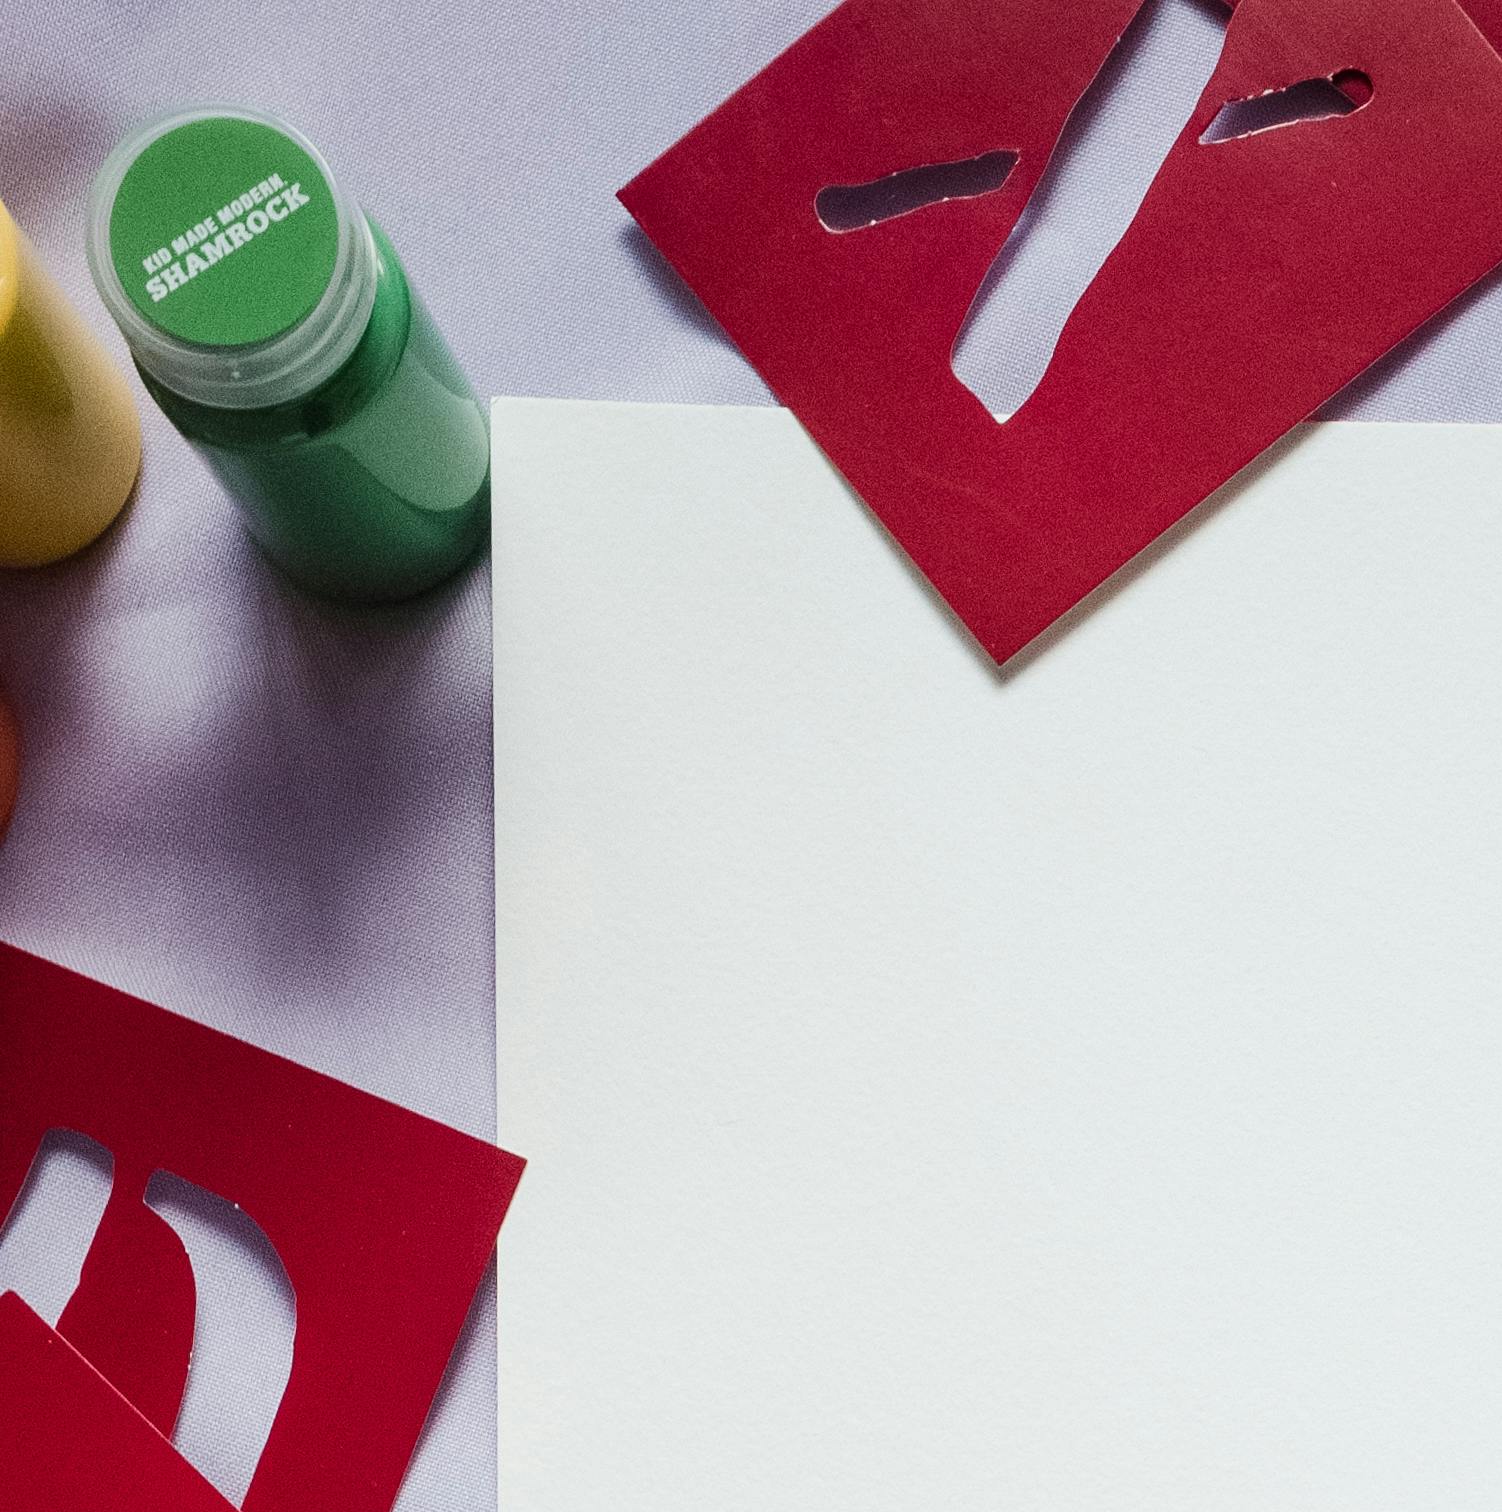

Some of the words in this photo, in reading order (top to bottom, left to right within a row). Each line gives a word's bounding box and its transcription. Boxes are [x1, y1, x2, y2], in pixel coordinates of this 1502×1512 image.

[142, 247, 173, 275] KID
[171, 216, 219, 256] MADE
[145, 182, 310, 302] SHAMROCK
